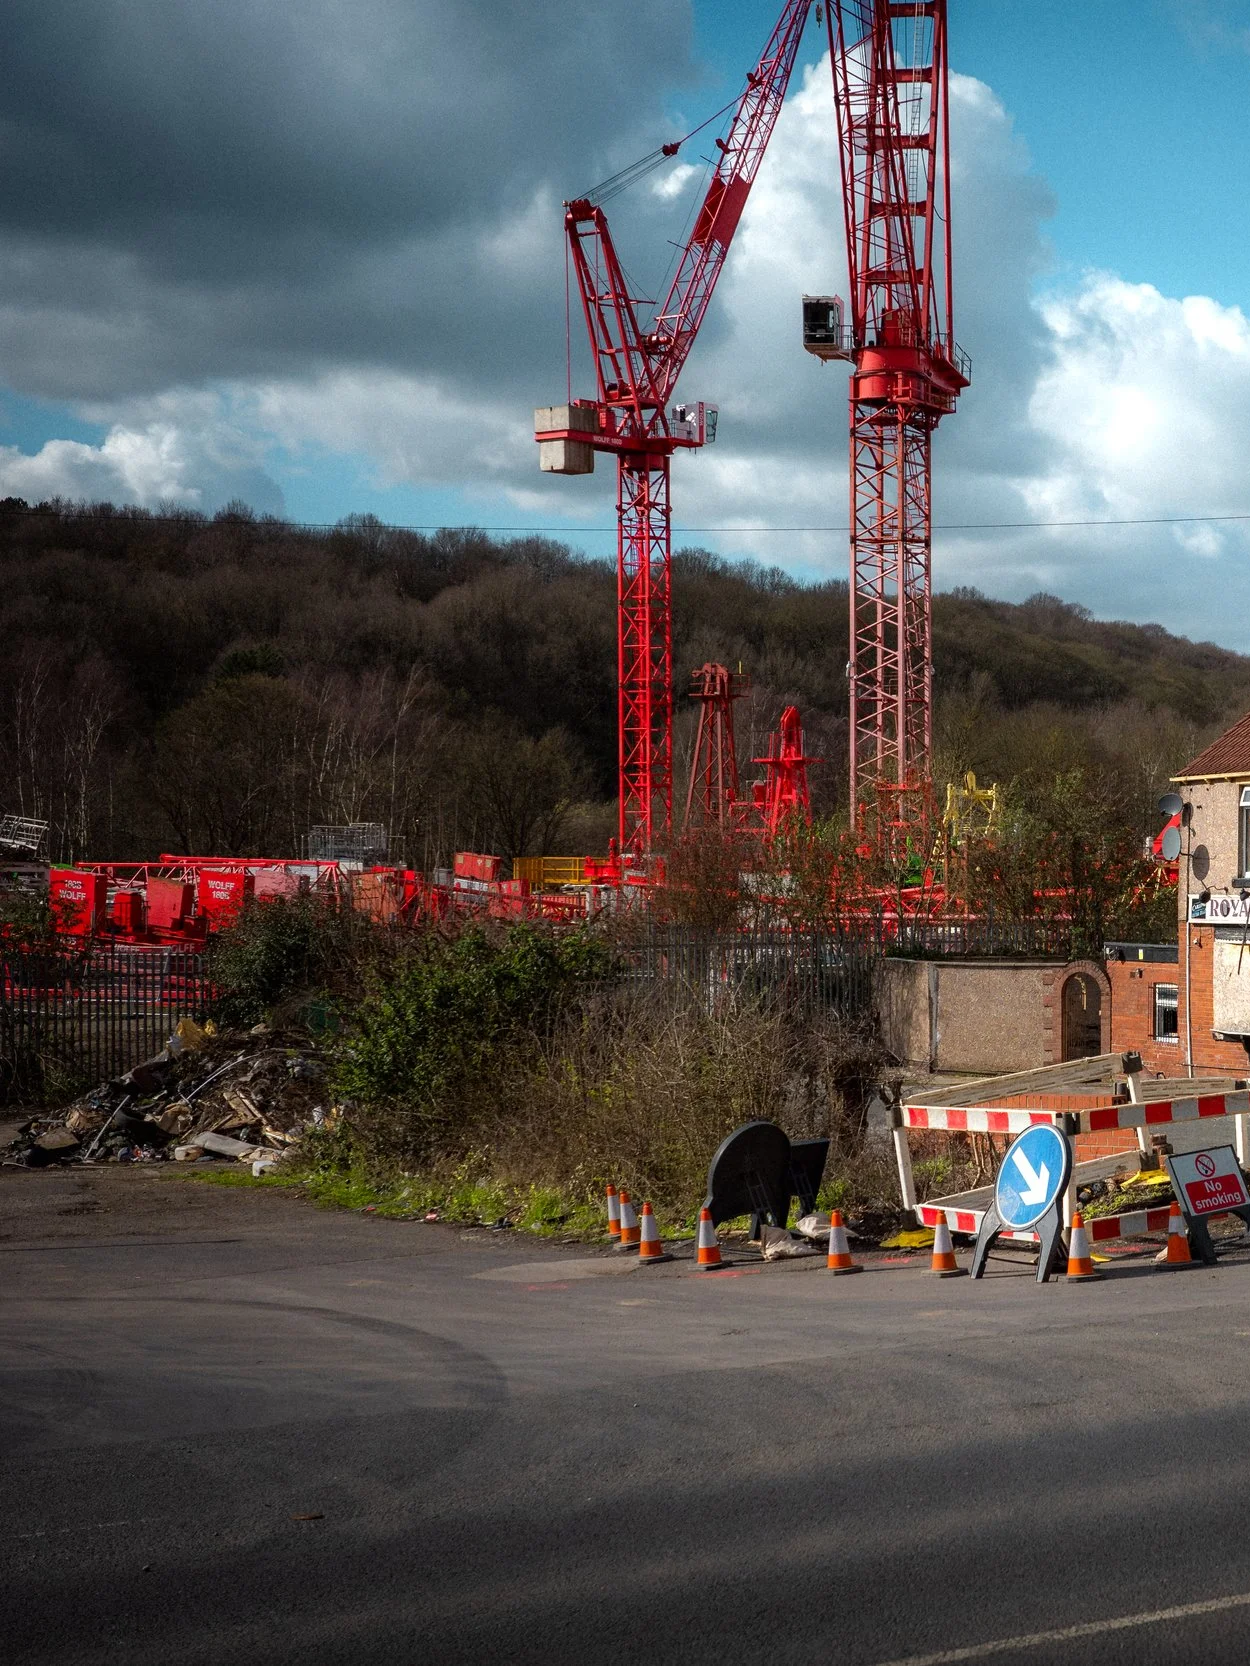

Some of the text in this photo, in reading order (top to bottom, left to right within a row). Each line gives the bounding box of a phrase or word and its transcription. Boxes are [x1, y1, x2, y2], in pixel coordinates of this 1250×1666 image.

[593, 435, 609, 443] WOLFF
[208, 880, 235, 890] WOLFF
[59, 889, 86, 900] WOLFF
[1204, 1181, 1222, 1193] No
[1195, 1192, 1242, 1210] smoking
